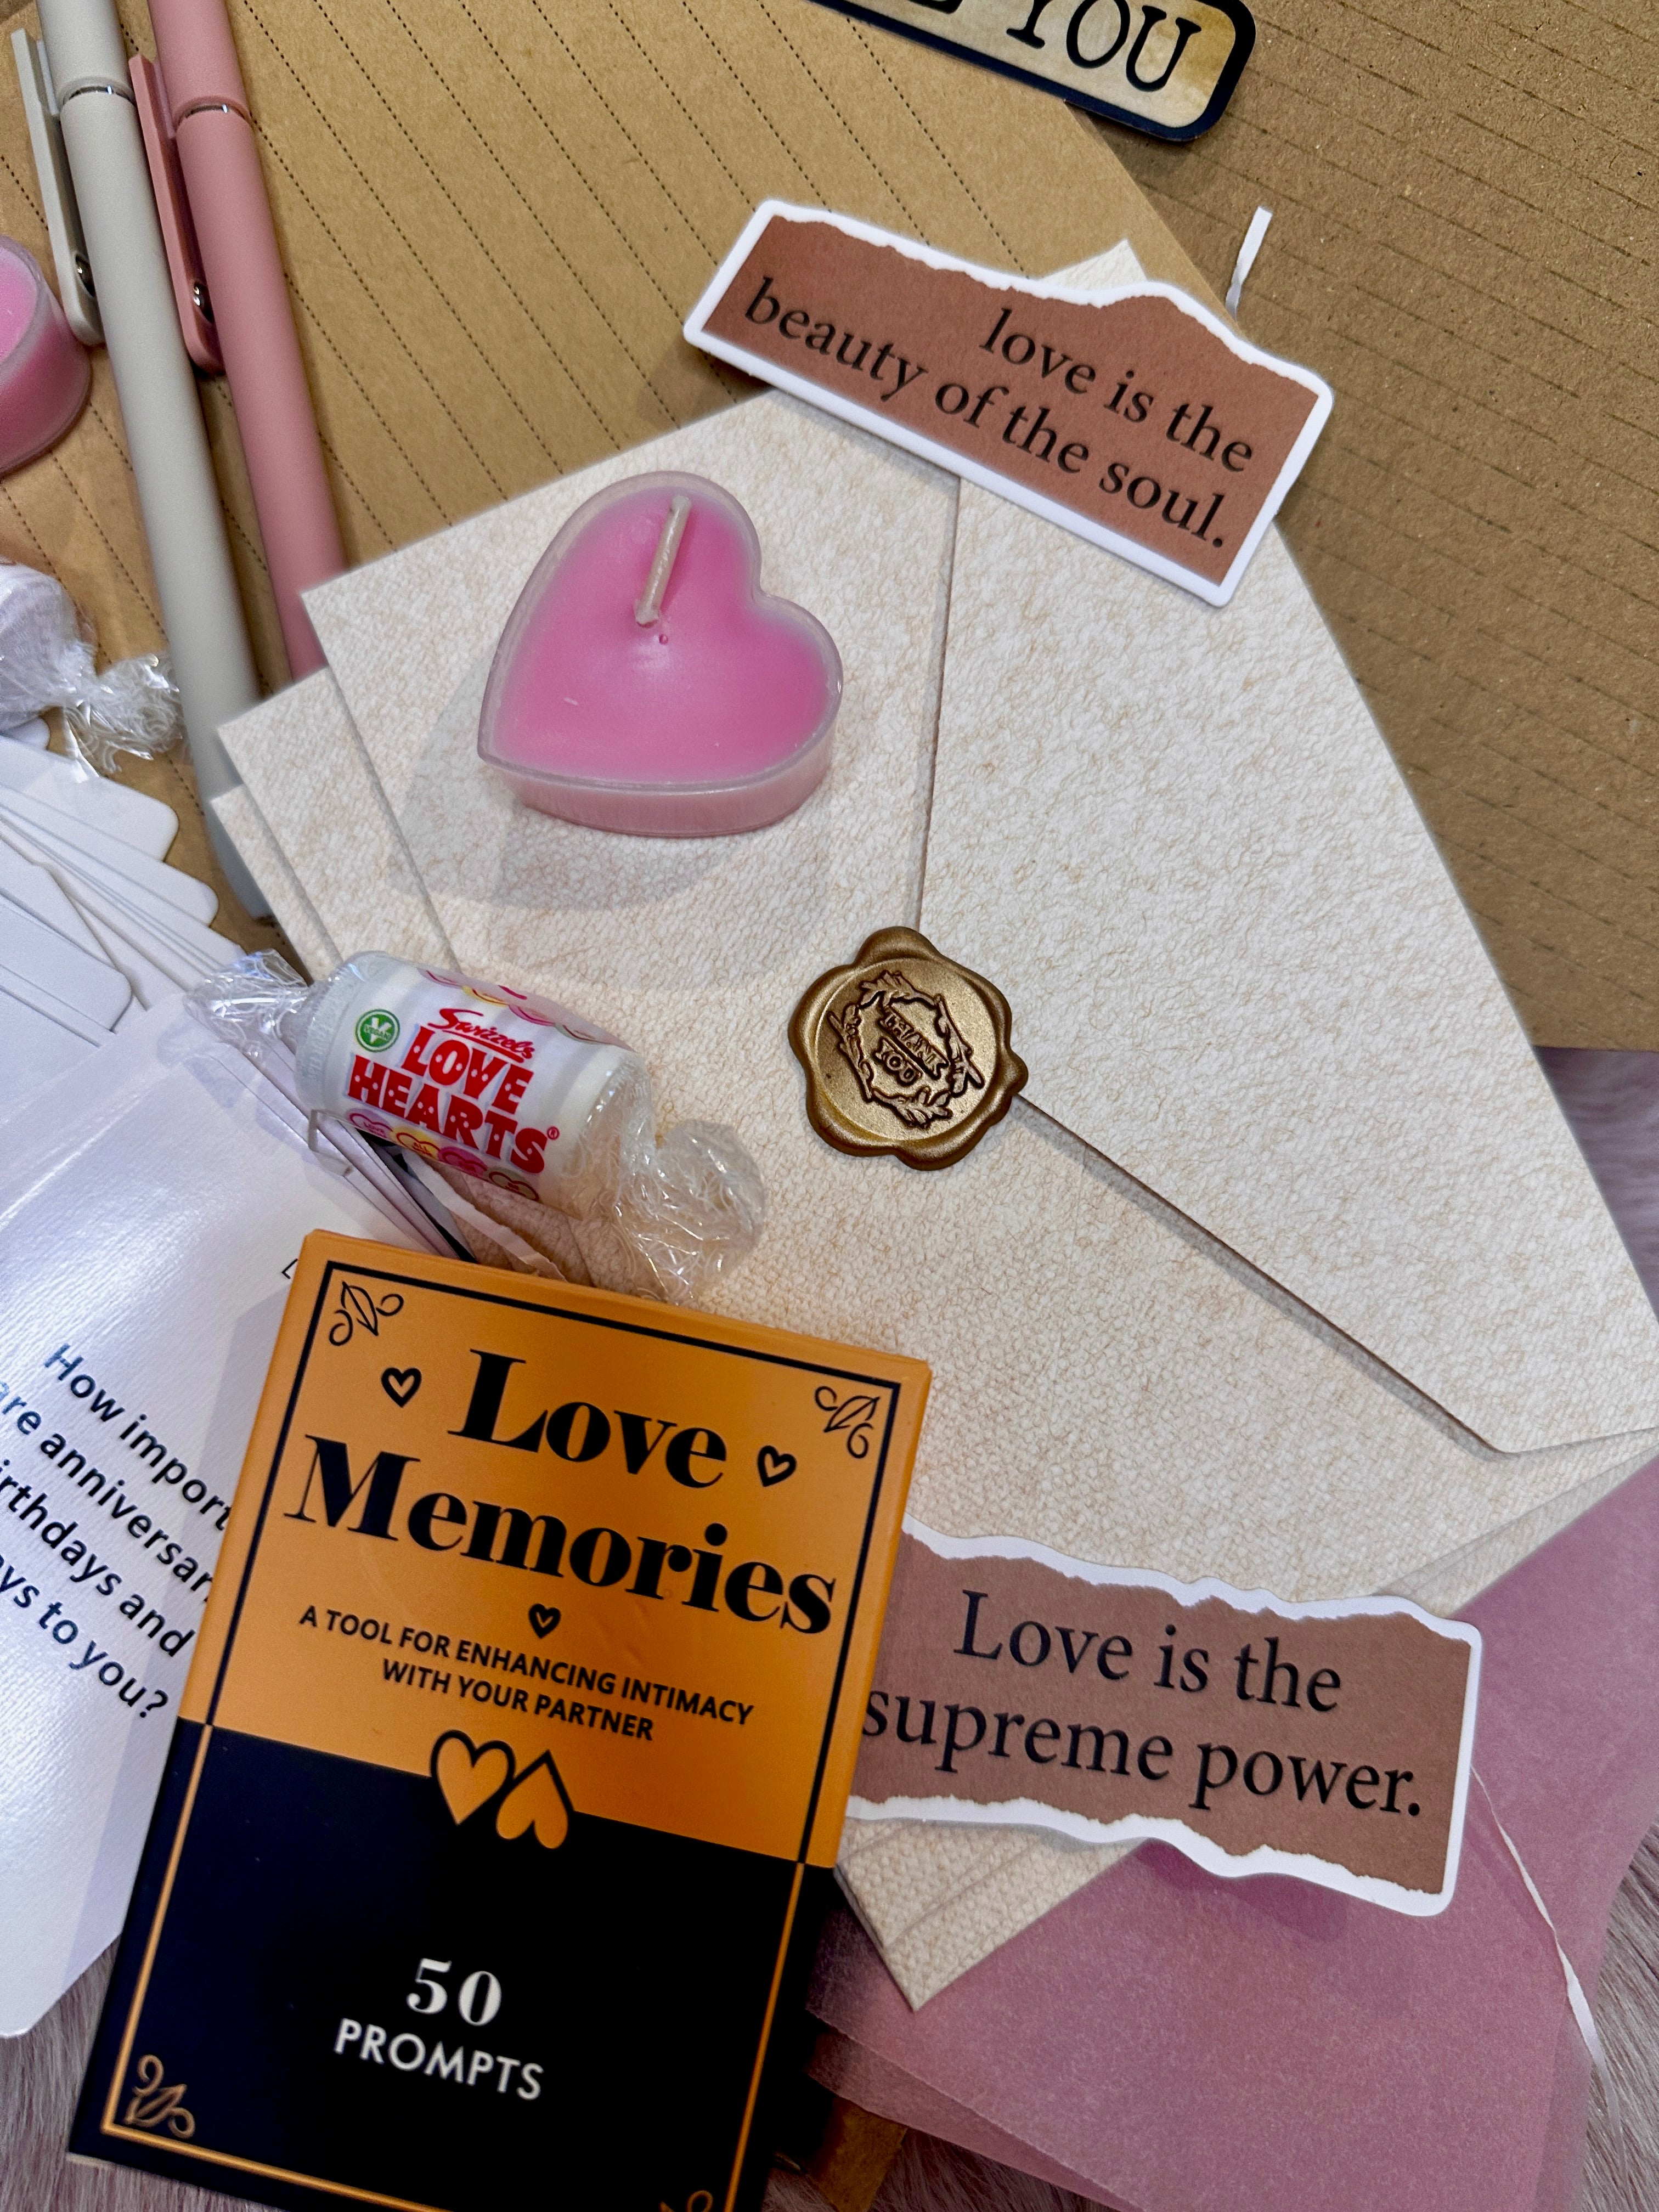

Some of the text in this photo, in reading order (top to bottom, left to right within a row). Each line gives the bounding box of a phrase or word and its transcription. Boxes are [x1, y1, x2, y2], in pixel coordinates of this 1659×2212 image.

[745, 274, 1224, 547] beauty of the soul.
[979, 307, 1252, 472] love is the
[402, 1026, 533, 1114] LOVE
[428, 1008, 535, 1060] Swizzels
[44, 1343, 125, 1422] How
[448, 1349, 726, 1488] Love
[40, 1434, 213, 1601] anniversar
[284, 1435, 835, 1634] Memories
[39, 1602, 78, 1644] to
[70, 1641, 168, 1718] you?
[120, 1594, 195, 1657] and
[300, 1606, 754, 1725] A TOOL FOR ENHANCING INTIMACY
[953, 1590, 1340, 1712] Love is the
[383, 1659, 654, 1743] WITH YOUR PARTNER
[861, 1690, 1420, 1817] supreme power.
[408, 1959, 501, 2025] 50
[335, 2018, 543, 2099] PROMPTS
